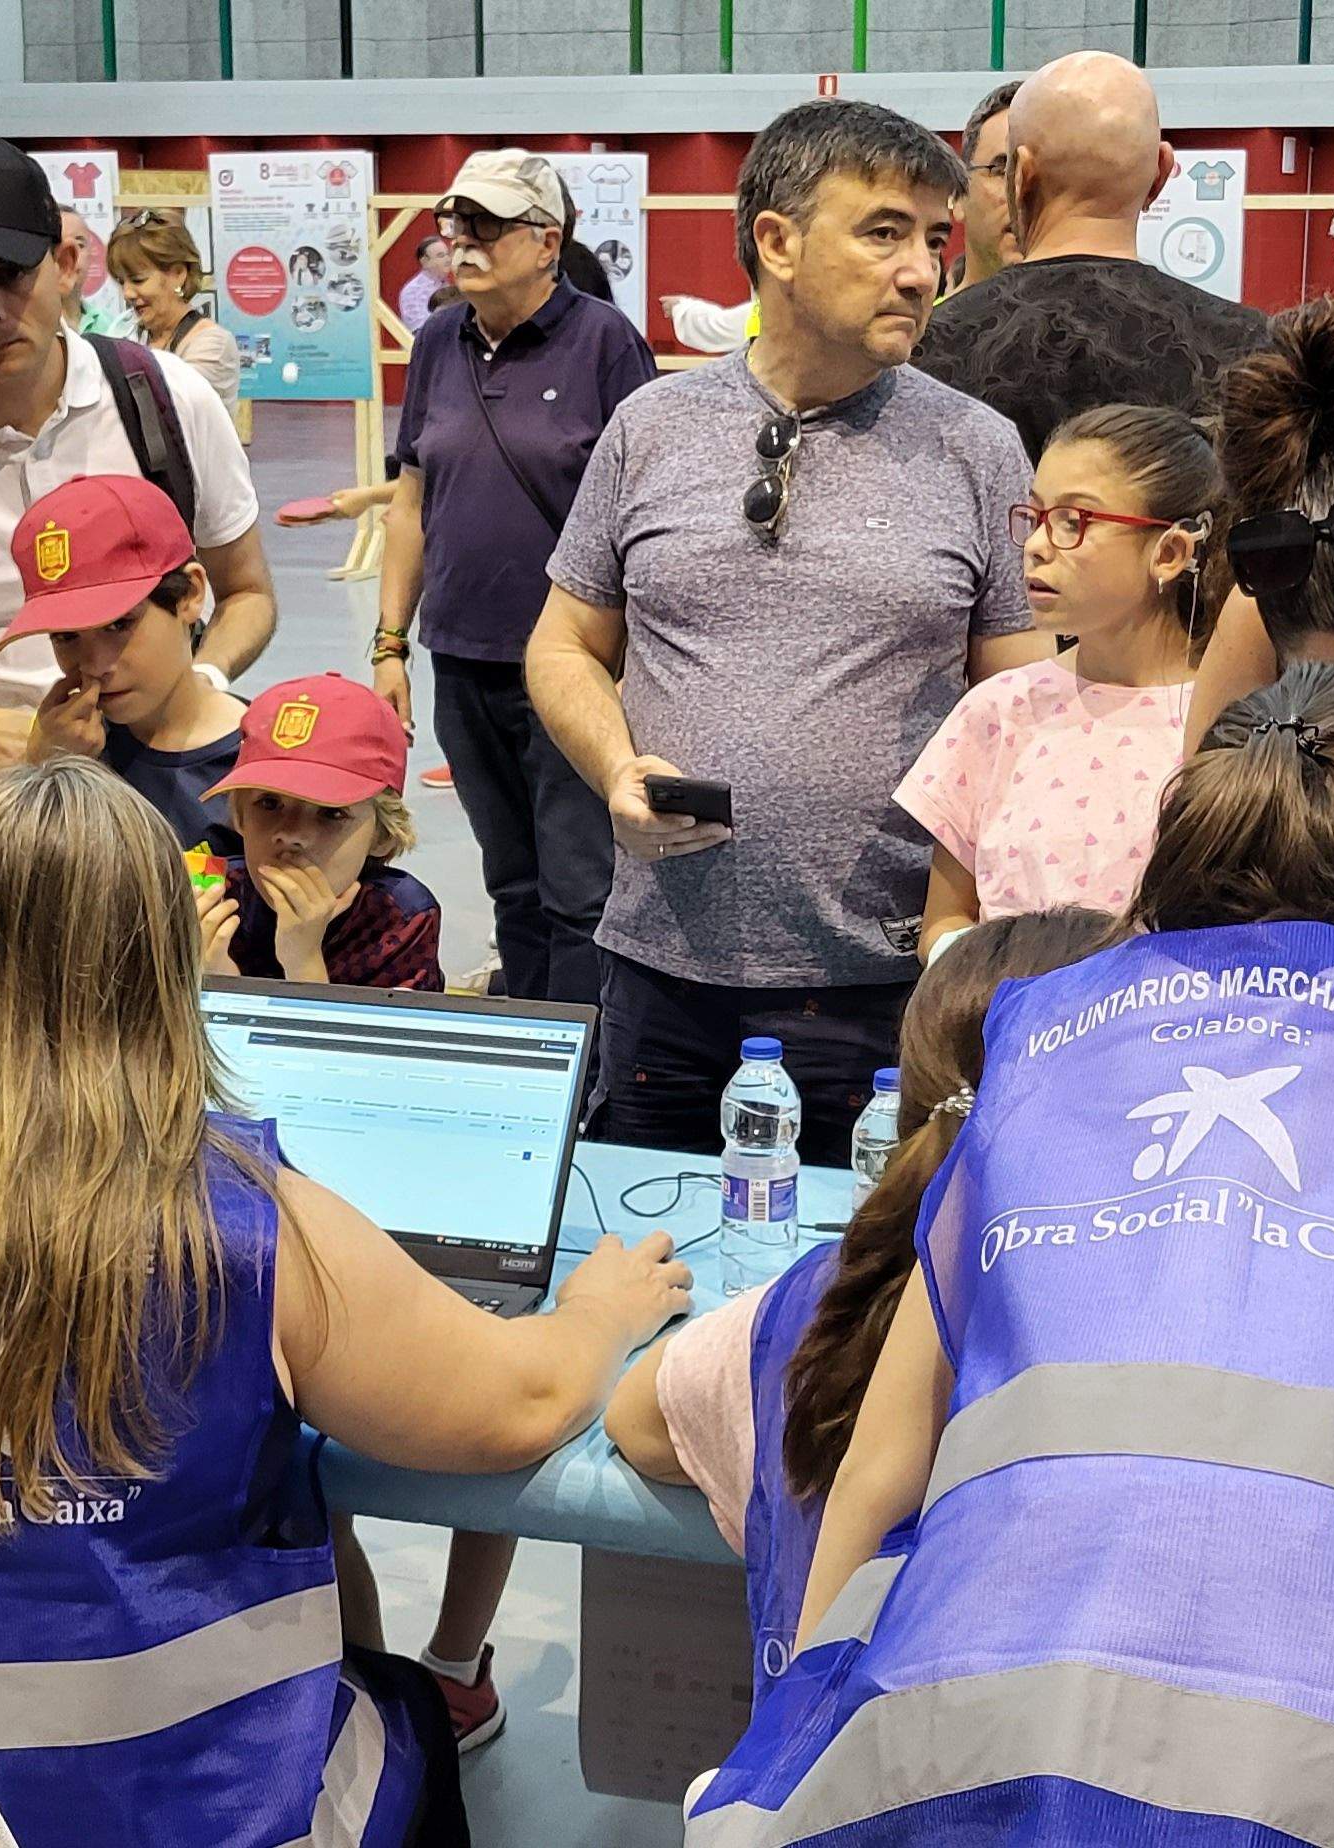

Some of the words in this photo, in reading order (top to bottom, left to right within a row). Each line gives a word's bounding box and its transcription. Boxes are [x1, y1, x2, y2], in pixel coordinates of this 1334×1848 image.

[1027, 969, 1213, 1059] VOLUNTARIOS
[1150, 1016, 1313, 1049] Colabora:
[980, 1209, 1076, 1275] Obra
[1091, 1188, 1230, 1246] Social
